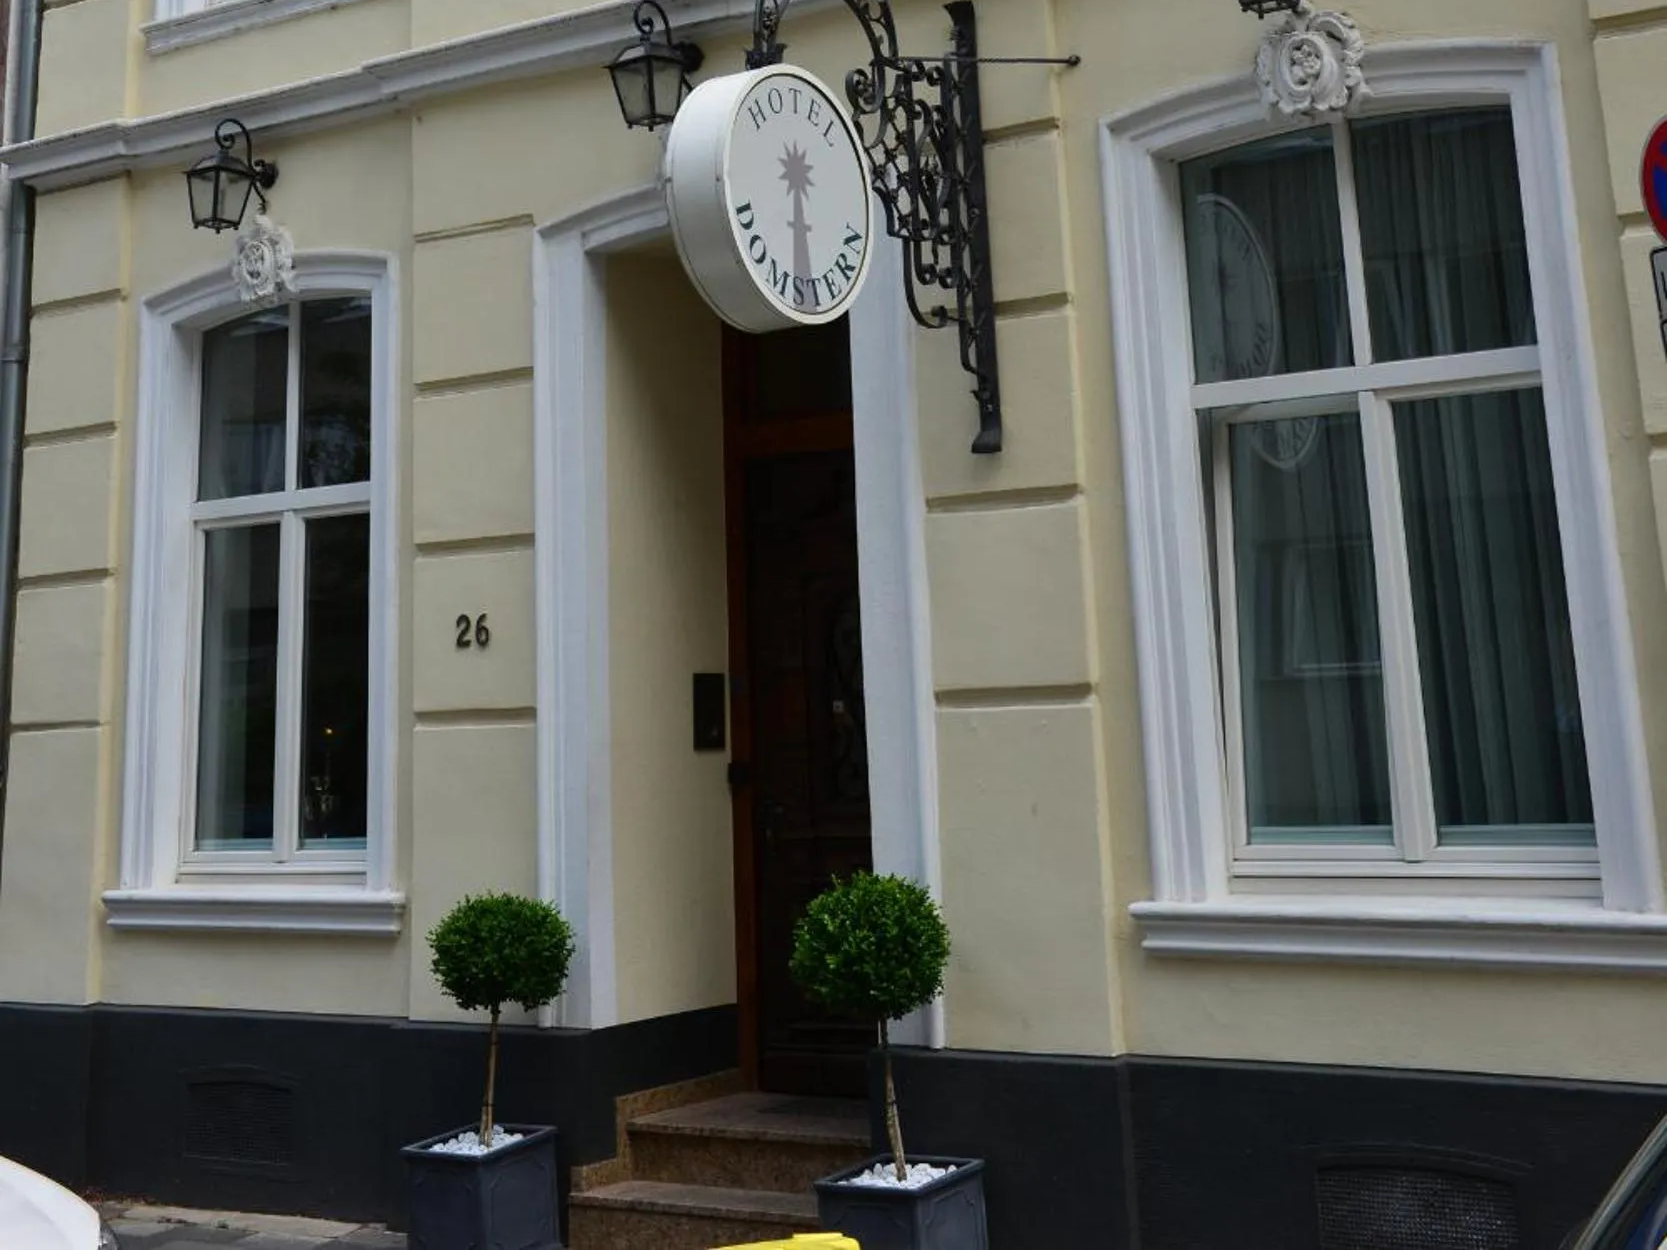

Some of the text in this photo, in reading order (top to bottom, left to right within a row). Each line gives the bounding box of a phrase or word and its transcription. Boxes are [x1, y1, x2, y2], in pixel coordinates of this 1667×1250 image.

[748, 87, 835, 148] HOTEL
[735, 199, 863, 309] DOMSTERN
[456, 613, 490, 649] 26
